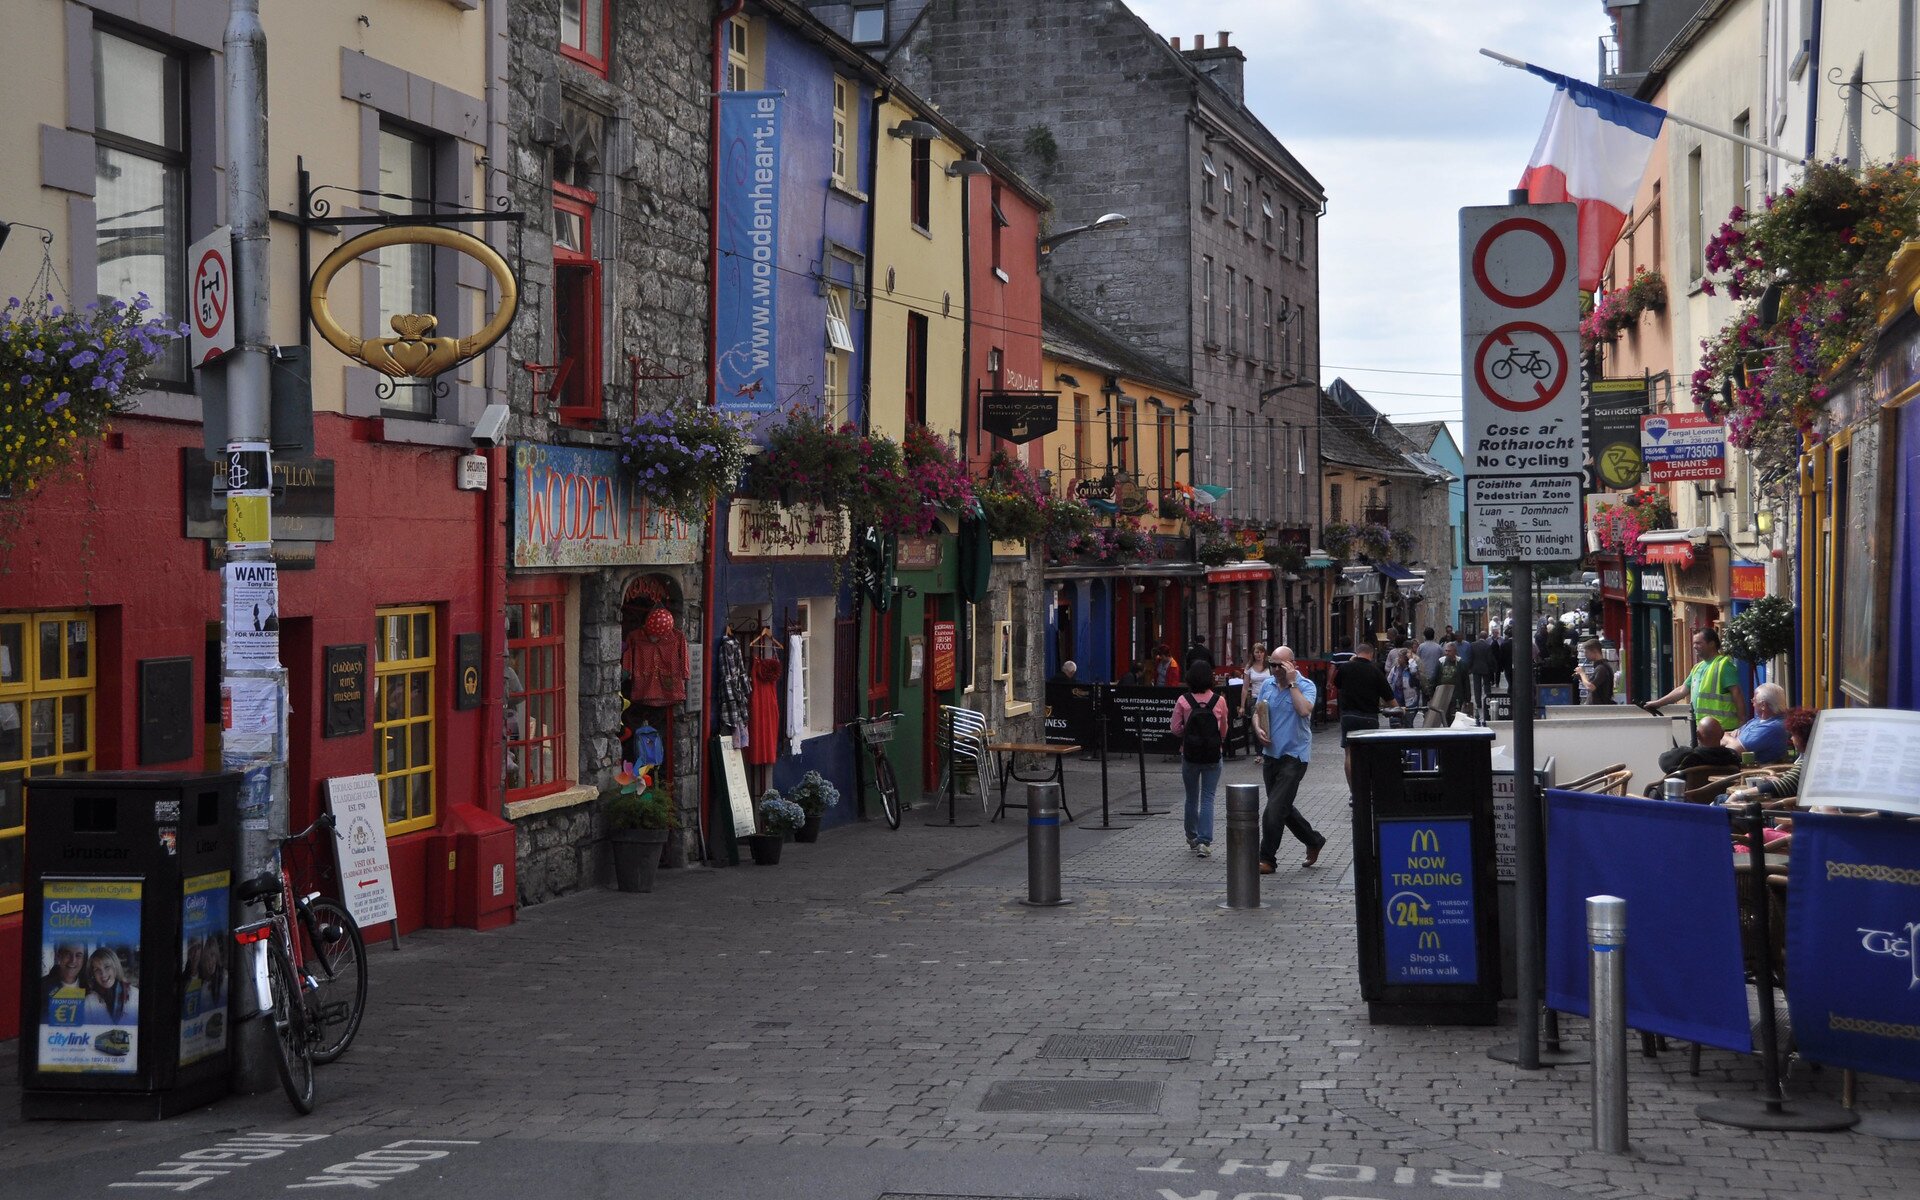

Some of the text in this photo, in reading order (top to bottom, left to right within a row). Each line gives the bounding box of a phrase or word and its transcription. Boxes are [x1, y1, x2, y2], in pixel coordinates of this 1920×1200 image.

[747, 97, 776, 368] www.woodenheart.ie
[202, 303, 211, 322] 5t
[750, 401, 772, 409] Delivery
[1594, 407, 1643, 416] barnacles
[1486, 424, 1558, 436] Cosc ar
[1686, 445, 1718, 458] 735060
[1476, 454, 1569, 469] No Cycling
[1666, 460, 1708, 468] TENANTS
[1653, 468, 1722, 479] NOT AFFECTED
[1477, 479, 1572, 489] Coisithe Amhain
[1080, 487, 1109, 496] QUAYS
[1476, 490, 1571, 501] Pedestrian Zone
[525, 464, 621, 546] WOODEN
[1480, 506, 1569, 516] Luan Domhnach
[1496, 518, 1551, 528] Mon. Sun.
[1519, 535, 1531, 544] TO
[1536, 534, 1574, 546] Midnight
[1476, 546, 1573, 558] Midnight TO 6:00a.m.
[235, 567, 277, 581] WANTE
[935, 643, 953, 651] FOOD
[1498, 707, 1509, 716] GO
[366, 858, 376, 866] OUR
[1408, 857, 1445, 869] NOW
[1391, 873, 1463, 886] TRADING
[90, 885, 106, 893] with
[50, 900, 95, 917] Galway
[1396, 902, 1419, 926] 24
[50, 914, 92, 928] Clifden
[1409, 953, 1451, 964] Shop St.
[1401, 966, 1459, 975] 3 Mins walk
[54, 1004, 77, 1023] €1
[48, 1032, 91, 1046] citylink
[286, 1139, 481, 1189] LOOK
[1136, 1157, 1502, 1189] RIGHT
